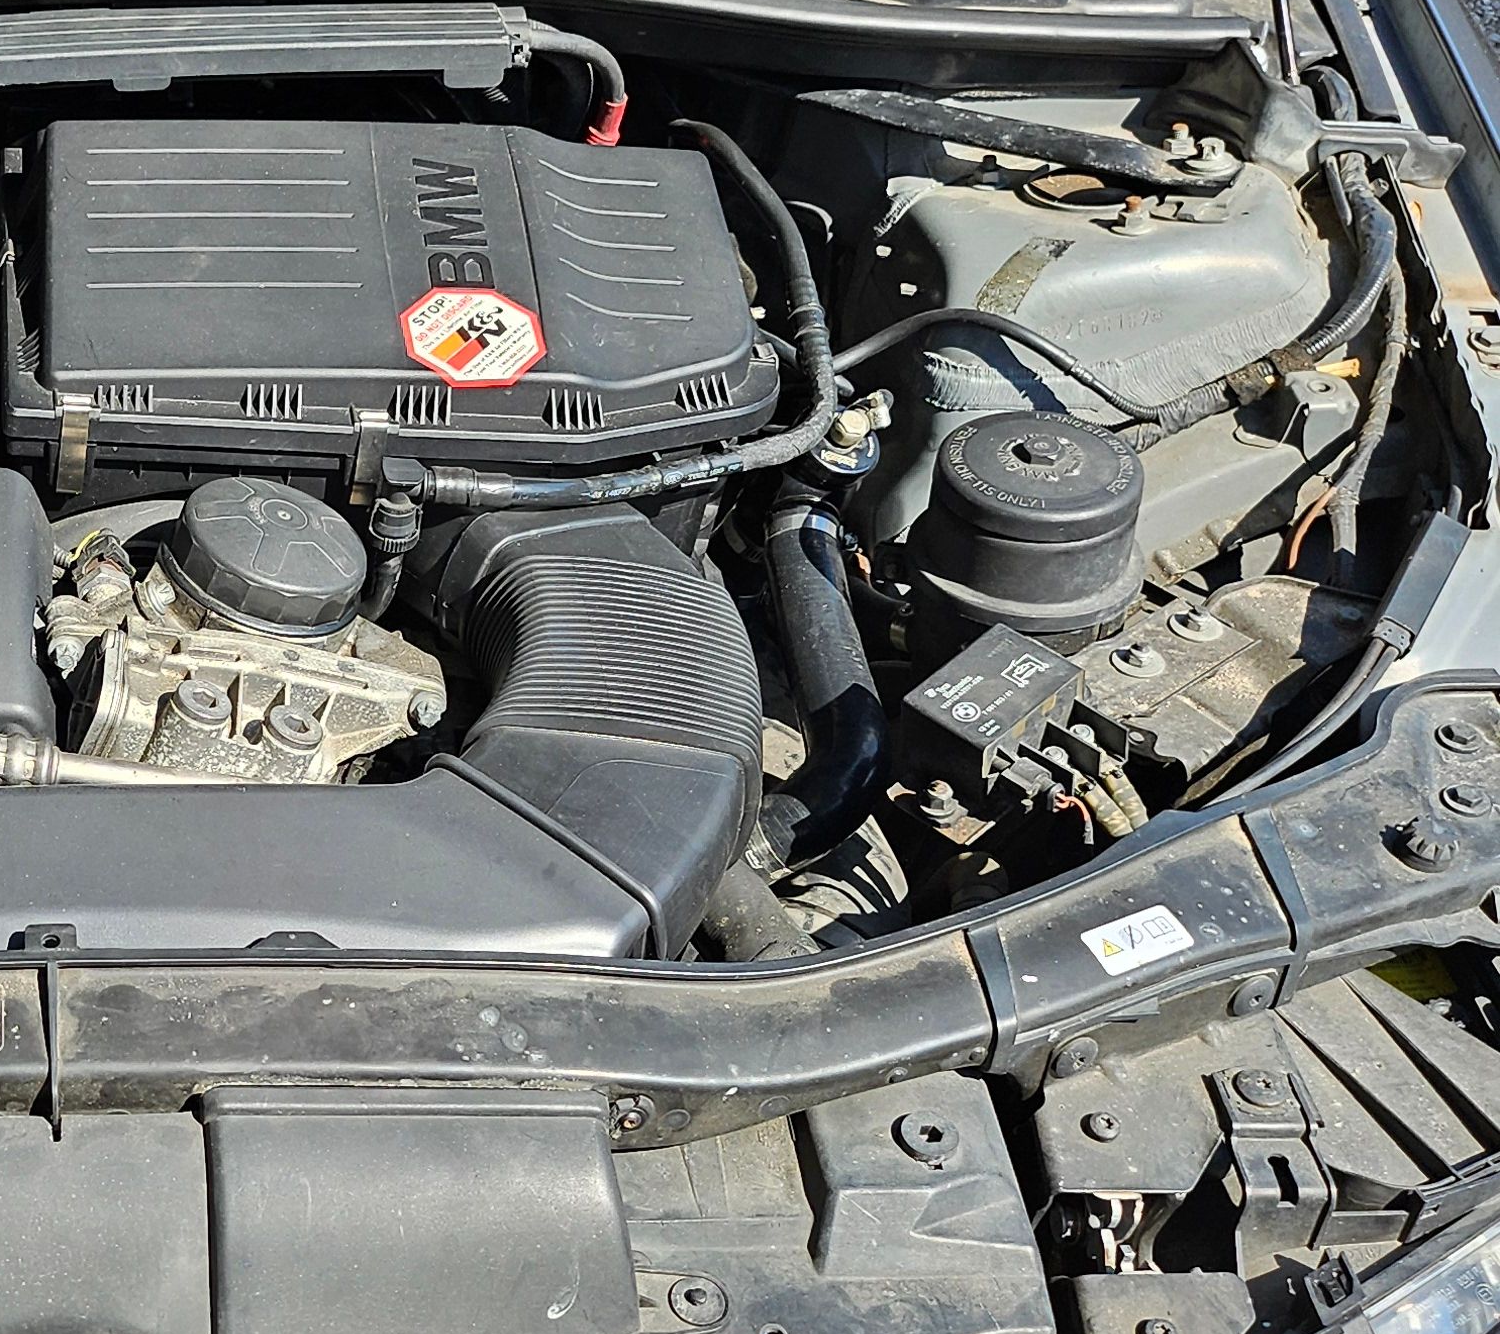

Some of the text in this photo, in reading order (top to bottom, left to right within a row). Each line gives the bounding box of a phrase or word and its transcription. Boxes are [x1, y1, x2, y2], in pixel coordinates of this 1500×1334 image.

[412, 158, 495, 289] BMW
[412, 295, 452, 327] STOP!
[416, 295, 473, 342] DO NOT DISCARD
[457, 306, 508, 350] K&N
[949, 426, 978, 468] PENTOSIN
